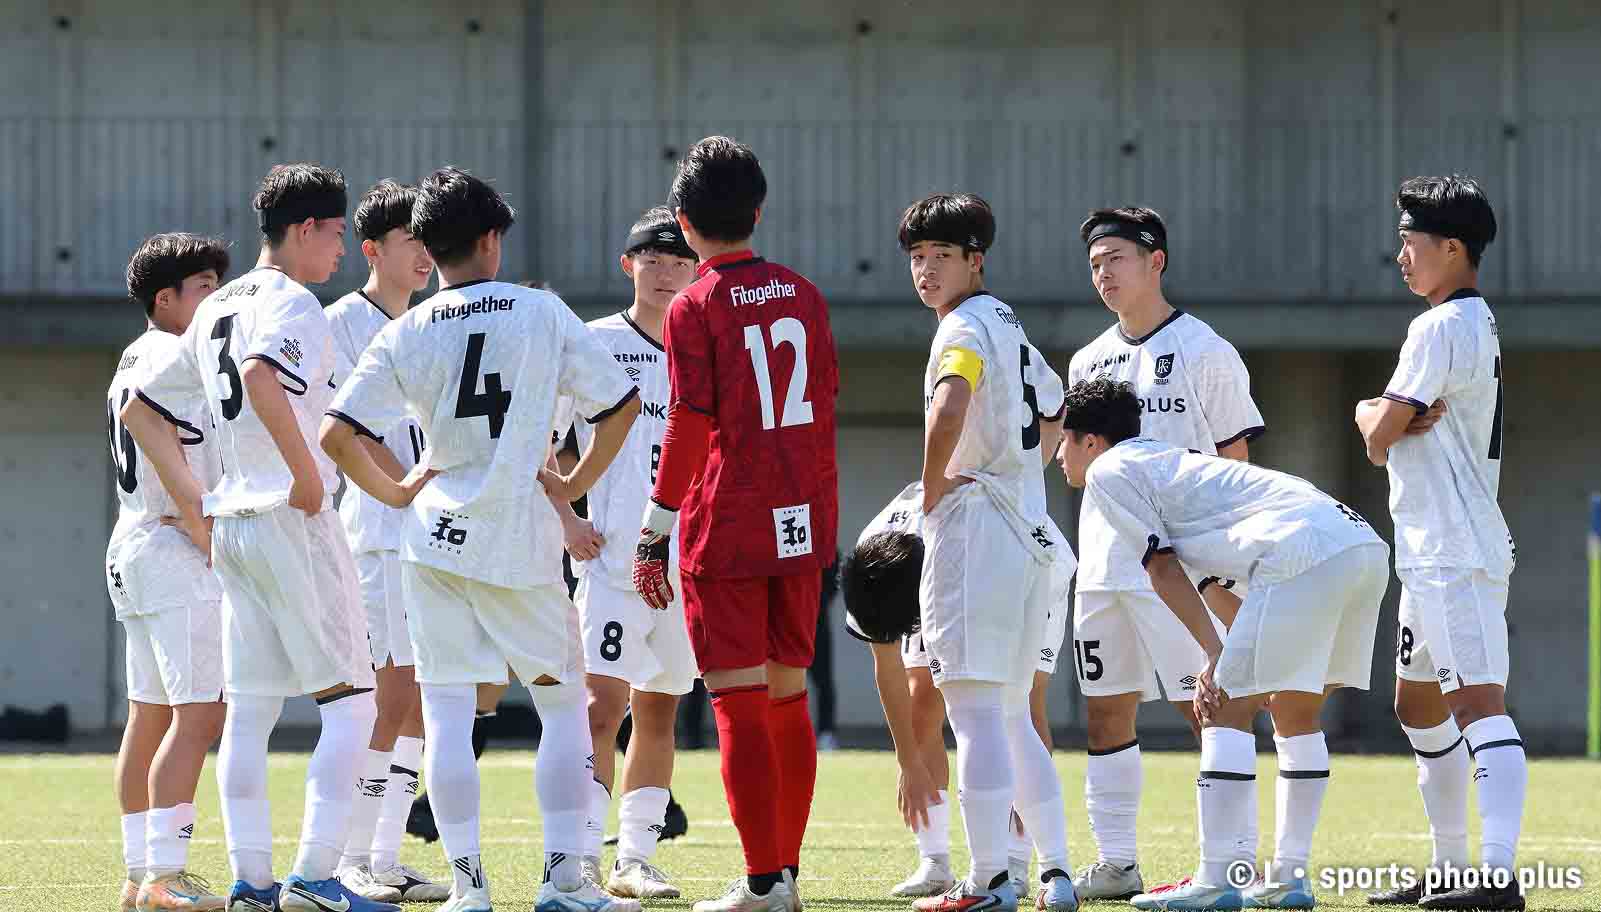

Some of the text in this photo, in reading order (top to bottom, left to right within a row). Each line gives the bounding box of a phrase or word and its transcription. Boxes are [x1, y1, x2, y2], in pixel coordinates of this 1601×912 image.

[432, 296, 516, 323] Fitogether
[731, 279, 797, 306] Fitogether
[210, 312, 243, 421] 3
[454, 332, 513, 440] 4
[743, 317, 814, 431] 12
[640, 400, 667, 420] INK
[1019, 343, 1041, 450] 5
[1137, 397, 1186, 414] PLUS
[599, 620, 624, 662] 8
[1074, 639, 1104, 681] 15
